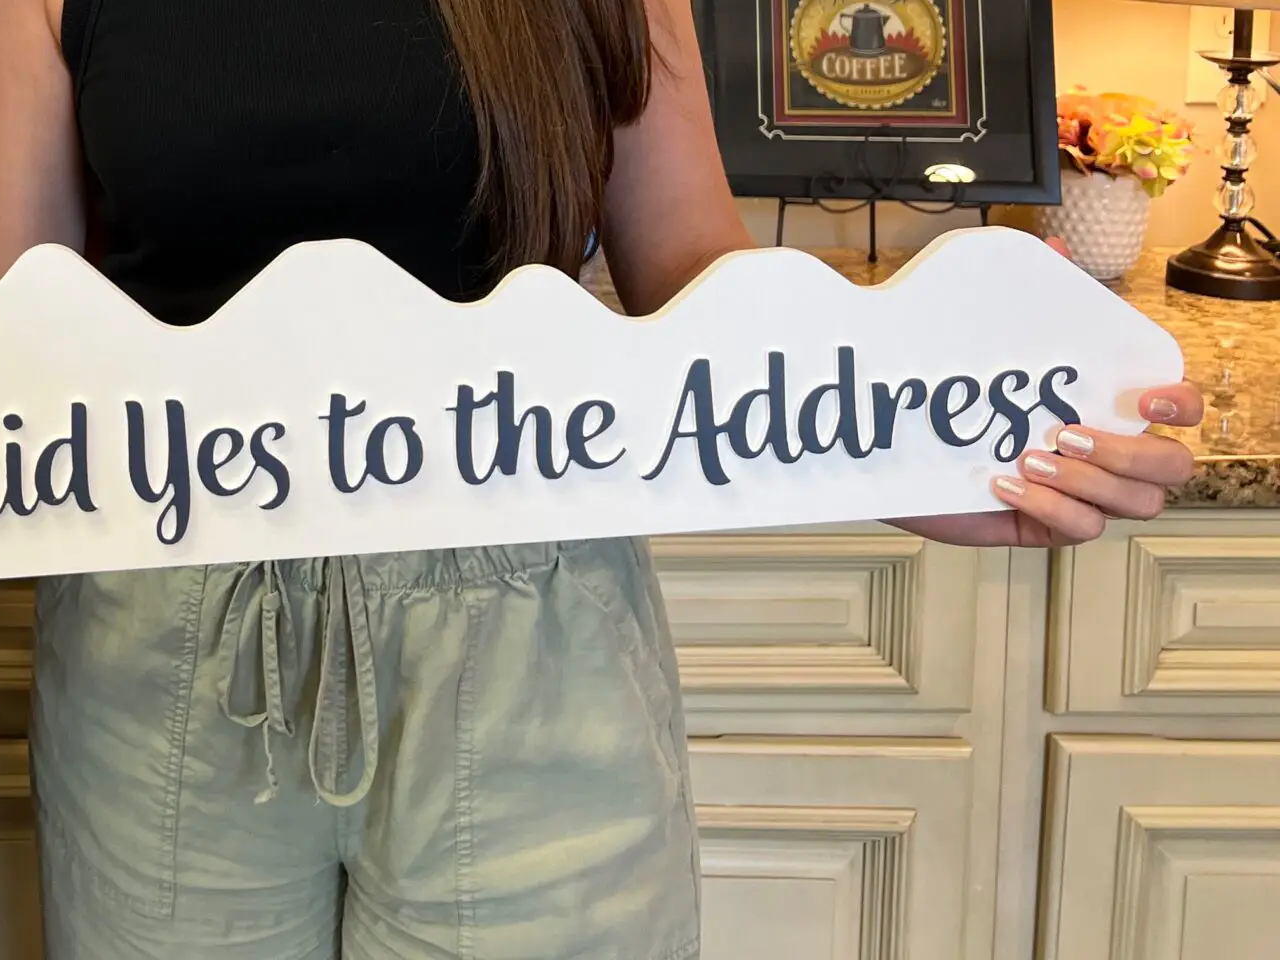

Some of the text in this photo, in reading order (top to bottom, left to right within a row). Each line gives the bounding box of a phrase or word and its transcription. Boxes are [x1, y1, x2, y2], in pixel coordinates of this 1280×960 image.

[821, 53, 908, 81] COFFEE
[125, 399, 291, 545] Yes
[318, 393, 424, 494] to
[446, 371, 627, 486] the
[640, 345, 1082, 486] Address
